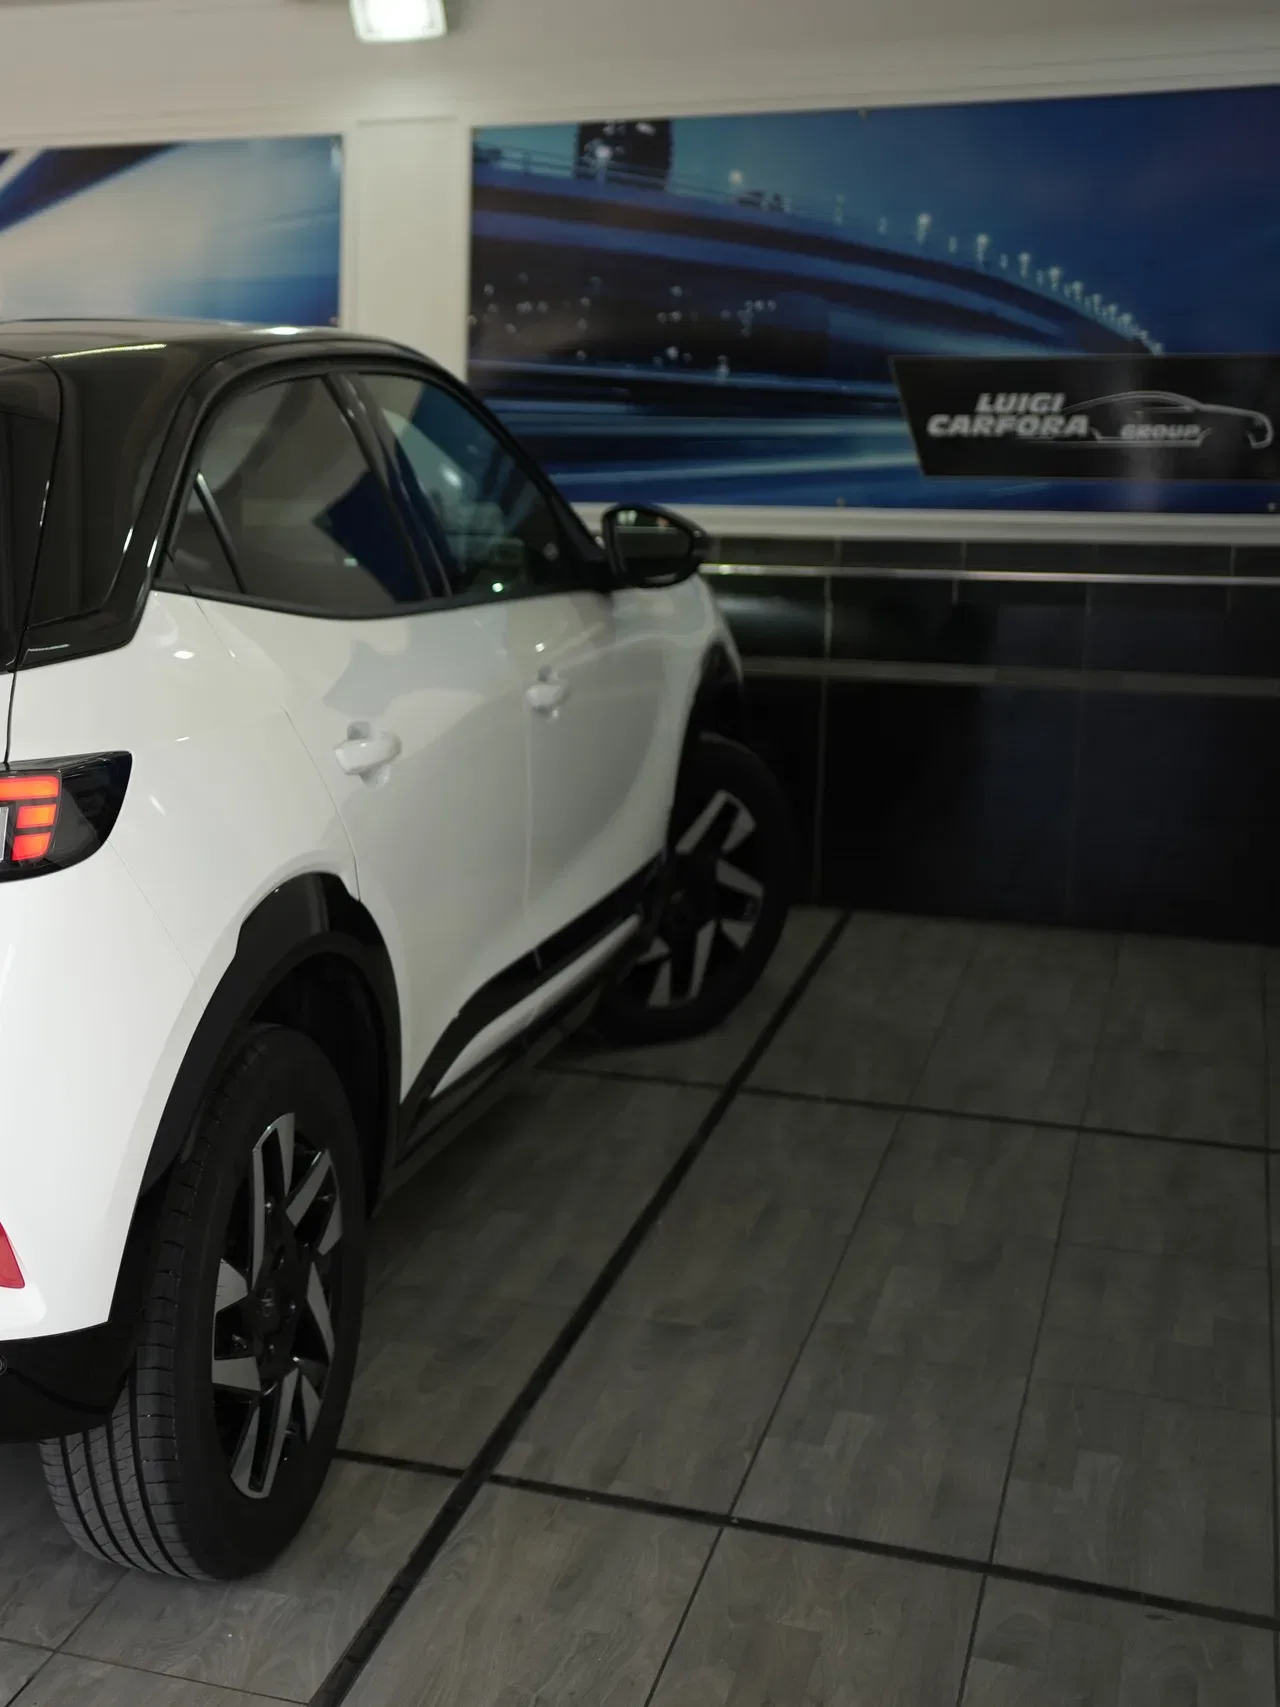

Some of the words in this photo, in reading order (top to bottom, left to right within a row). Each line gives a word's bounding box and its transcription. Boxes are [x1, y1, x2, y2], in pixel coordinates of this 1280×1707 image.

[975, 392, 1066, 413] LUIGI
[926, 414, 1090, 437] CARFORA
[1120, 424, 1201, 440] GROUP
